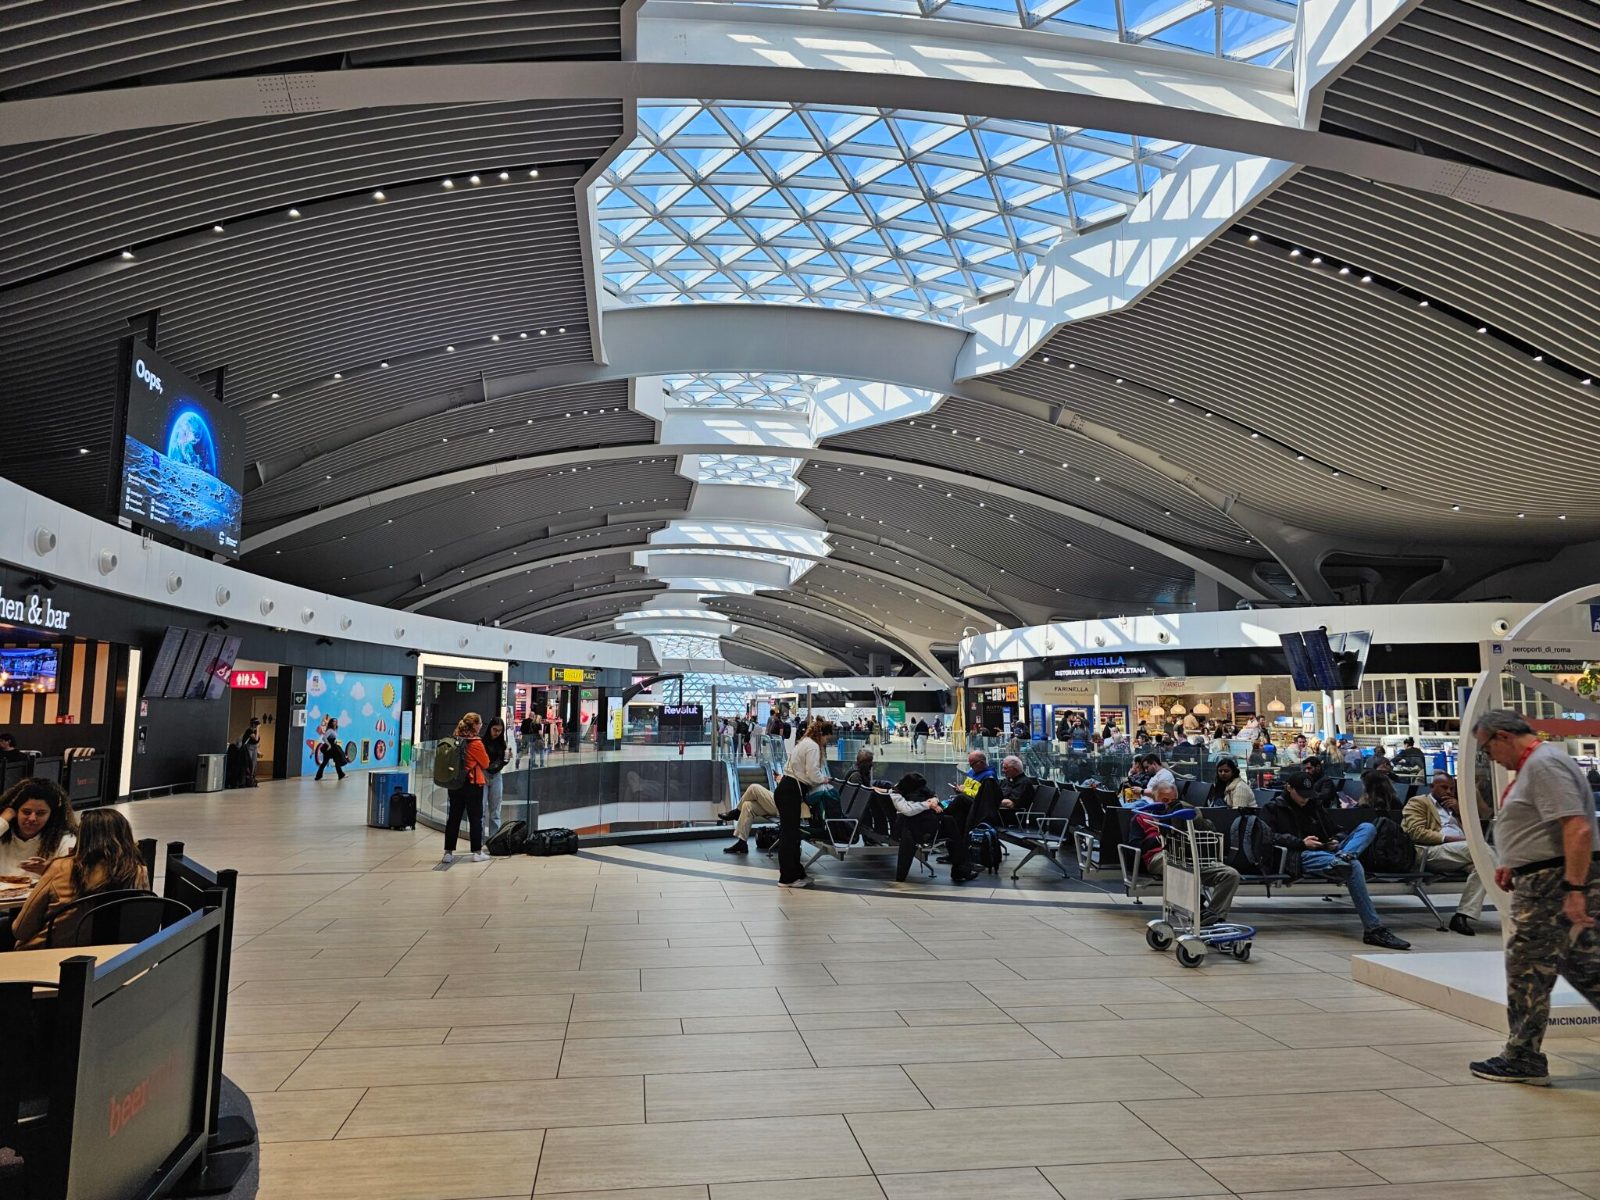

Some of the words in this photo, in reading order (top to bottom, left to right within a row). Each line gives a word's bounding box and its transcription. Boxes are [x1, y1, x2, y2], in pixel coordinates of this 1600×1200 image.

[136, 359, 163, 395] Oops,
[28, 594, 43, 626] &
[45, 597, 70, 629] bar
[1512, 646, 1571, 654] aeroporti_di_roma
[1069, 656, 1125, 667] FARINELLA
[663, 705, 698, 715] Revolut
